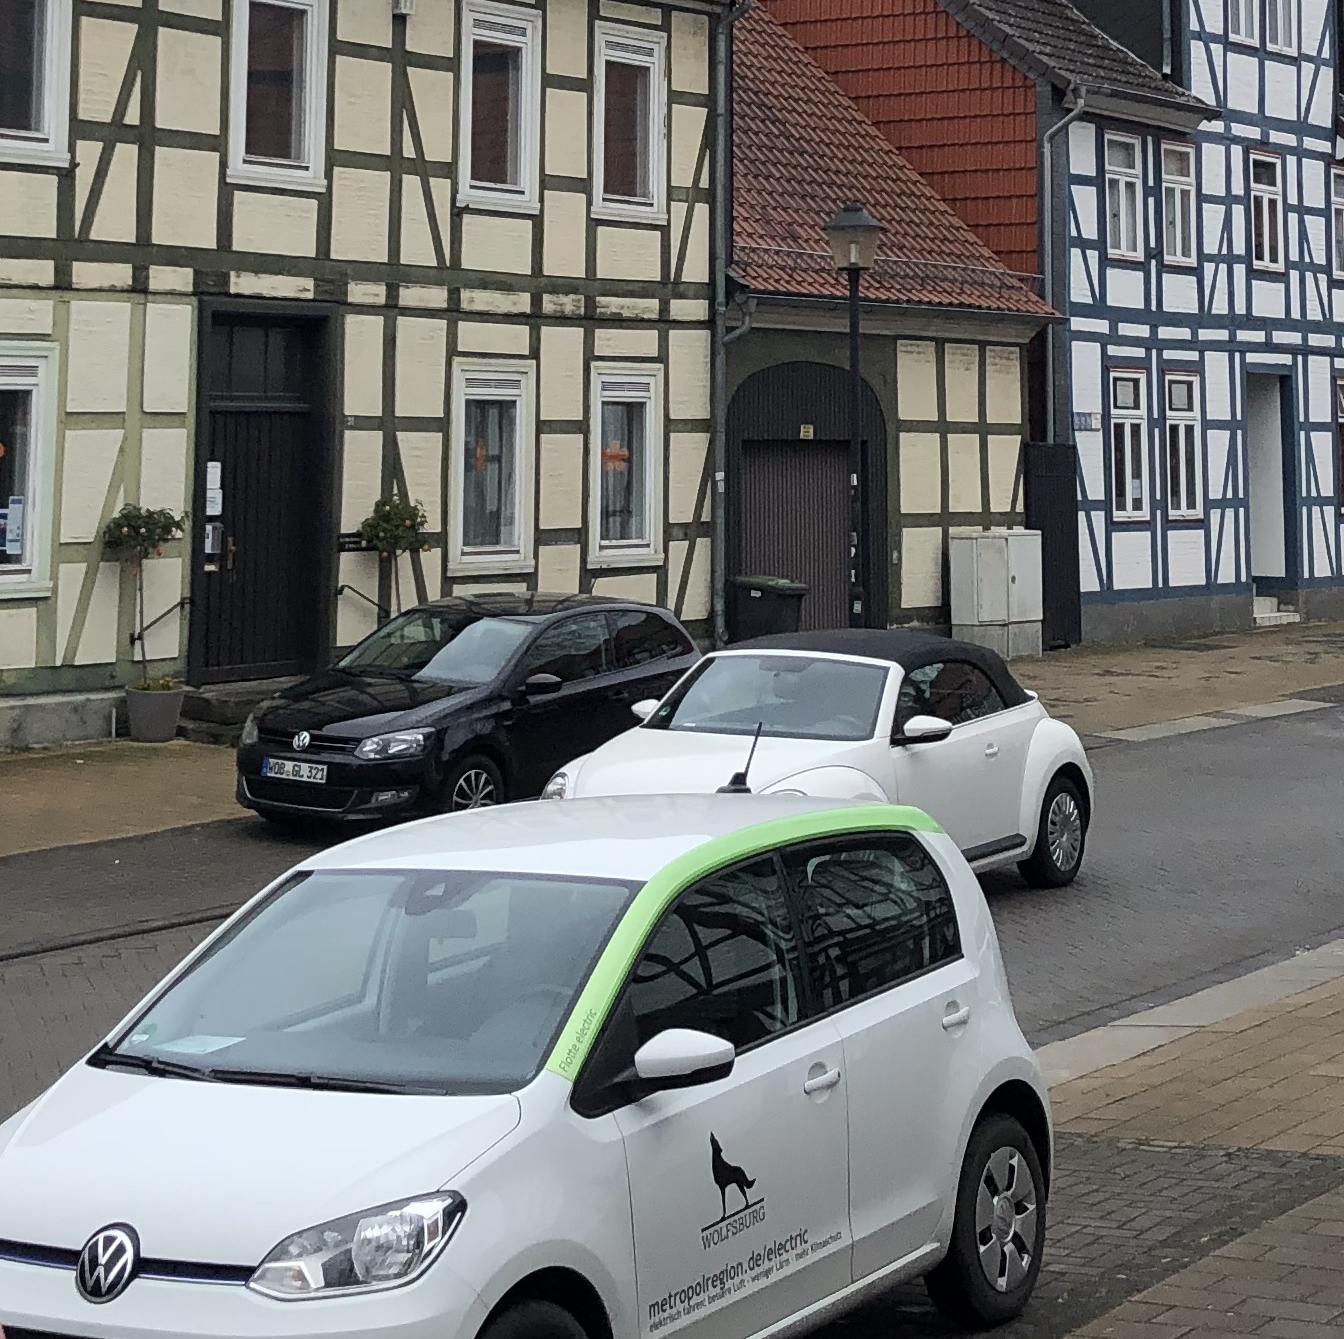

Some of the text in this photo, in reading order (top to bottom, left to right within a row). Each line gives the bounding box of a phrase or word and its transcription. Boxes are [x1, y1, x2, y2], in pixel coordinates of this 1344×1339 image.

[292, 764, 304, 778] GL
[307, 765, 325, 781] 321
[559, 1008, 597, 1073] Flotte electric
[701, 1205, 766, 1250] WOLFSBURG
[648, 1227, 809, 1320] metropolregion.de/electric
